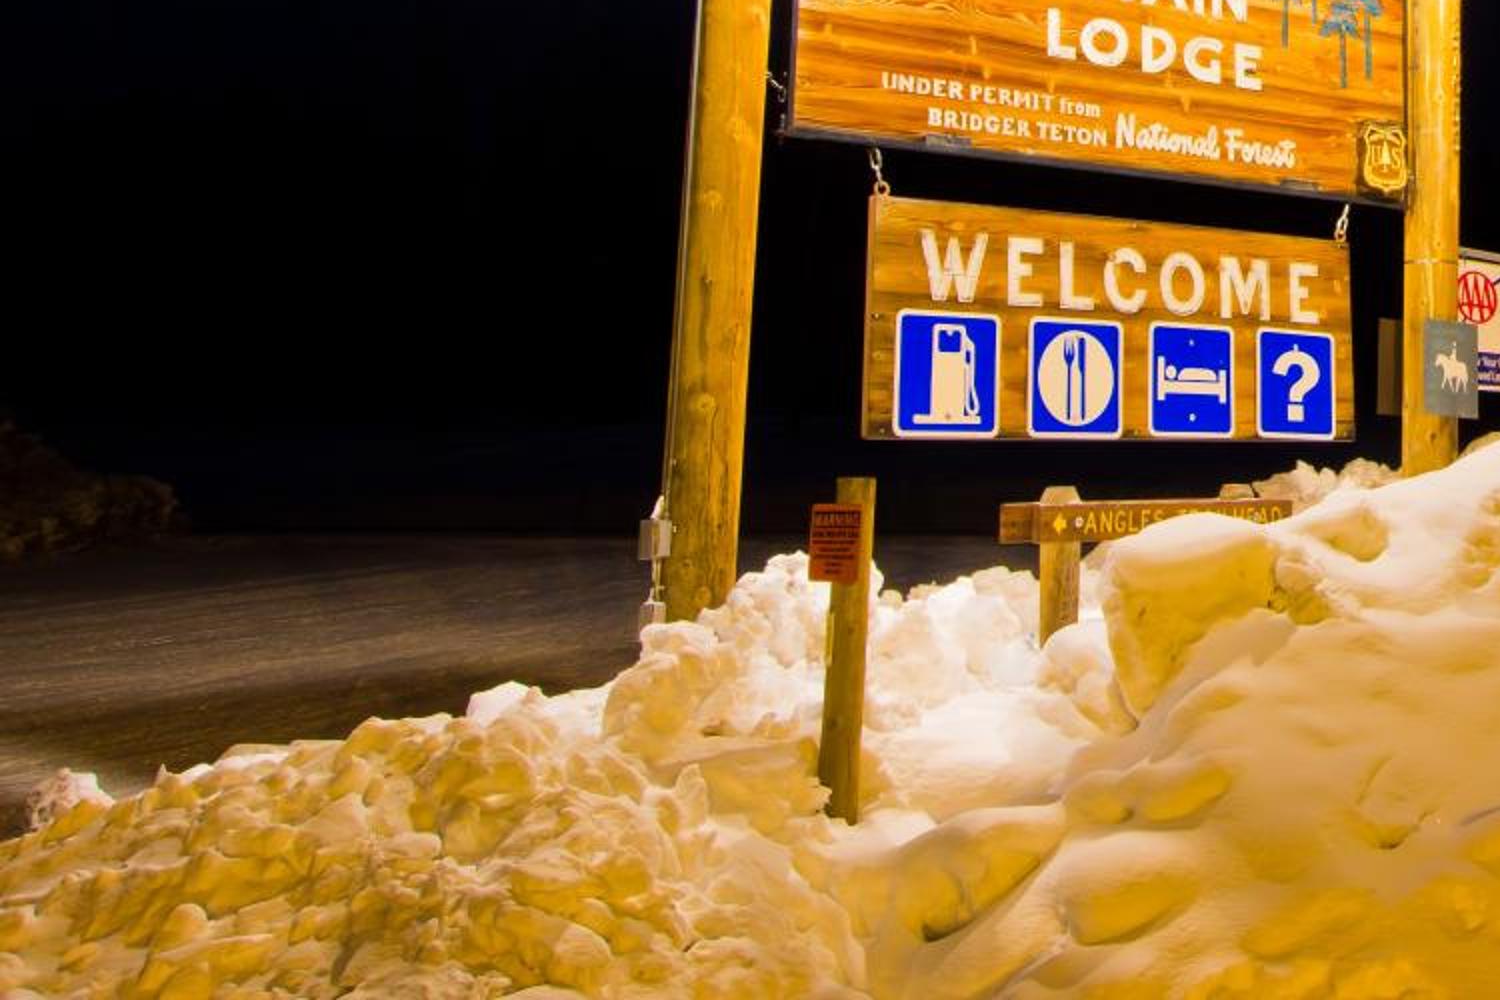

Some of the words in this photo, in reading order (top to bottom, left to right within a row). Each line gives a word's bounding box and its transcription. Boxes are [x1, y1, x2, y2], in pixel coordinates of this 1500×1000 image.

[1046, 7, 1264, 91] LODGE
[881, 71, 963, 100] UNDER
[969, 83, 1053, 112] PERMIT
[1059, 96, 1102, 118] from
[927, 107, 1031, 137] BRIDGER
[1036, 121, 1108, 147] TETON
[1114, 112, 1221, 161] National
[1224, 127, 1297, 169] Forest
[921, 228, 1320, 325] WELCOME
